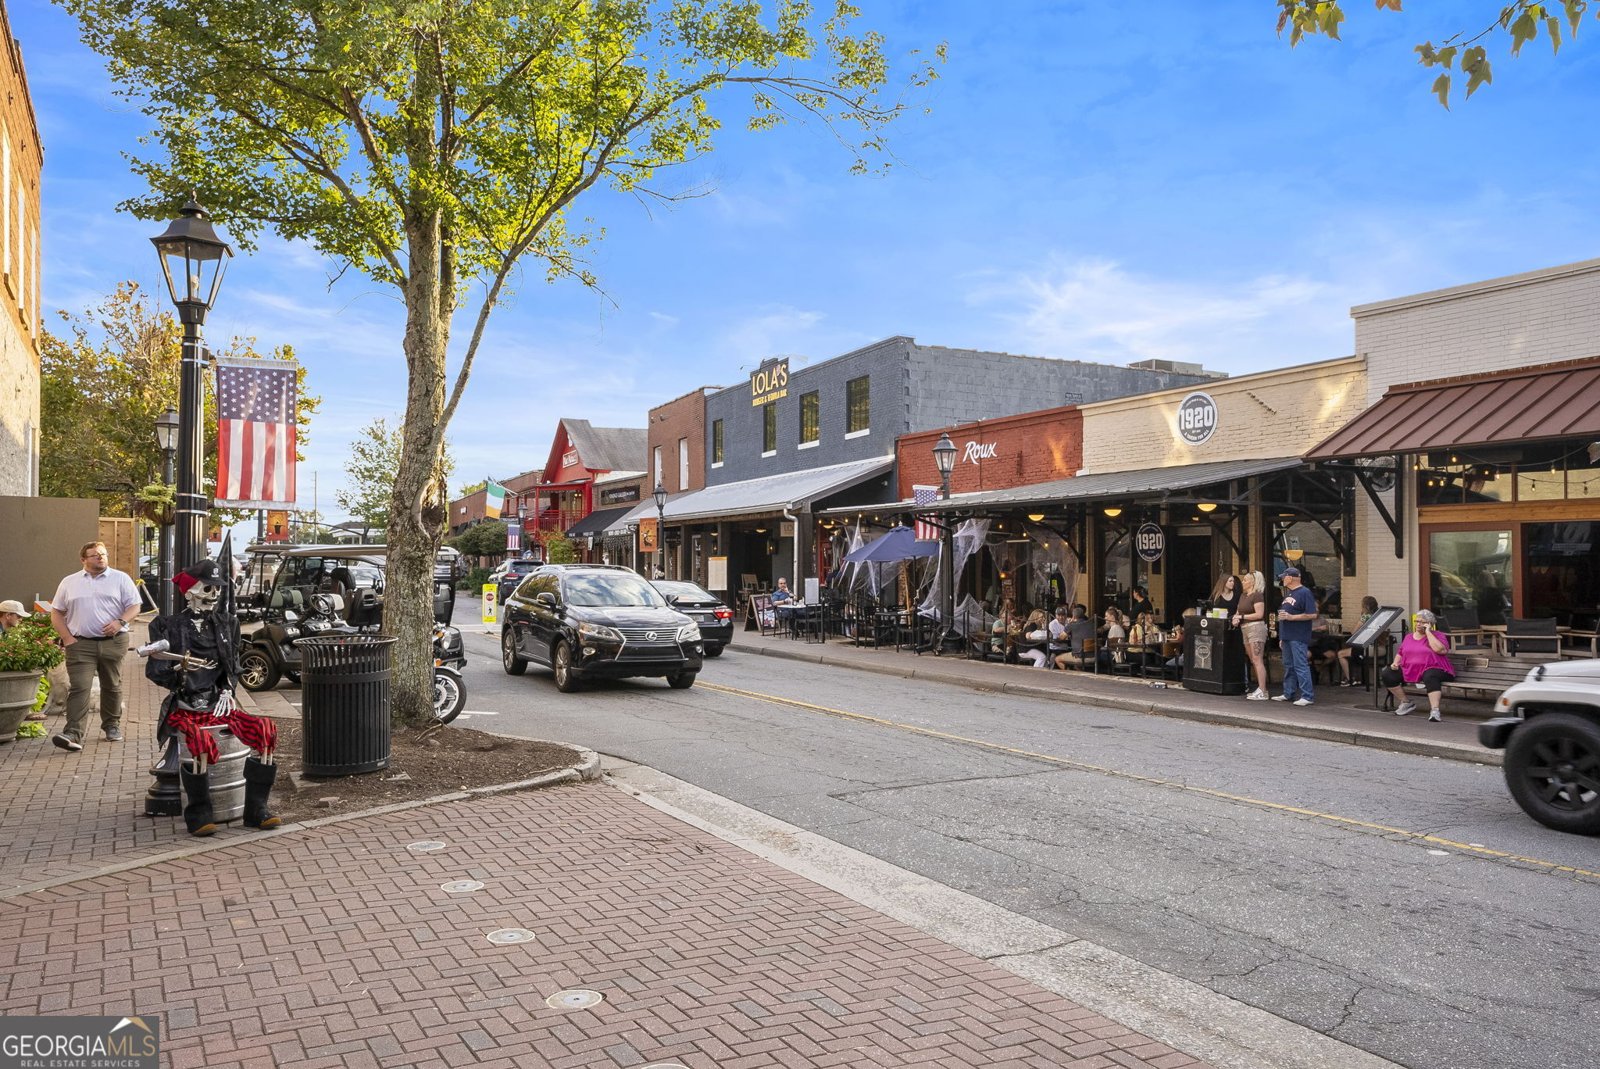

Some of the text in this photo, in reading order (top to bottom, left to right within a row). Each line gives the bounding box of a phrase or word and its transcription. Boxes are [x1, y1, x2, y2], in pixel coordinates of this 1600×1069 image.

[752, 364, 788, 396] LOLA'S
[1180, 405, 1214, 430] 1920
[962, 441, 998, 465] Roux
[1138, 533, 1163, 550] 1920
